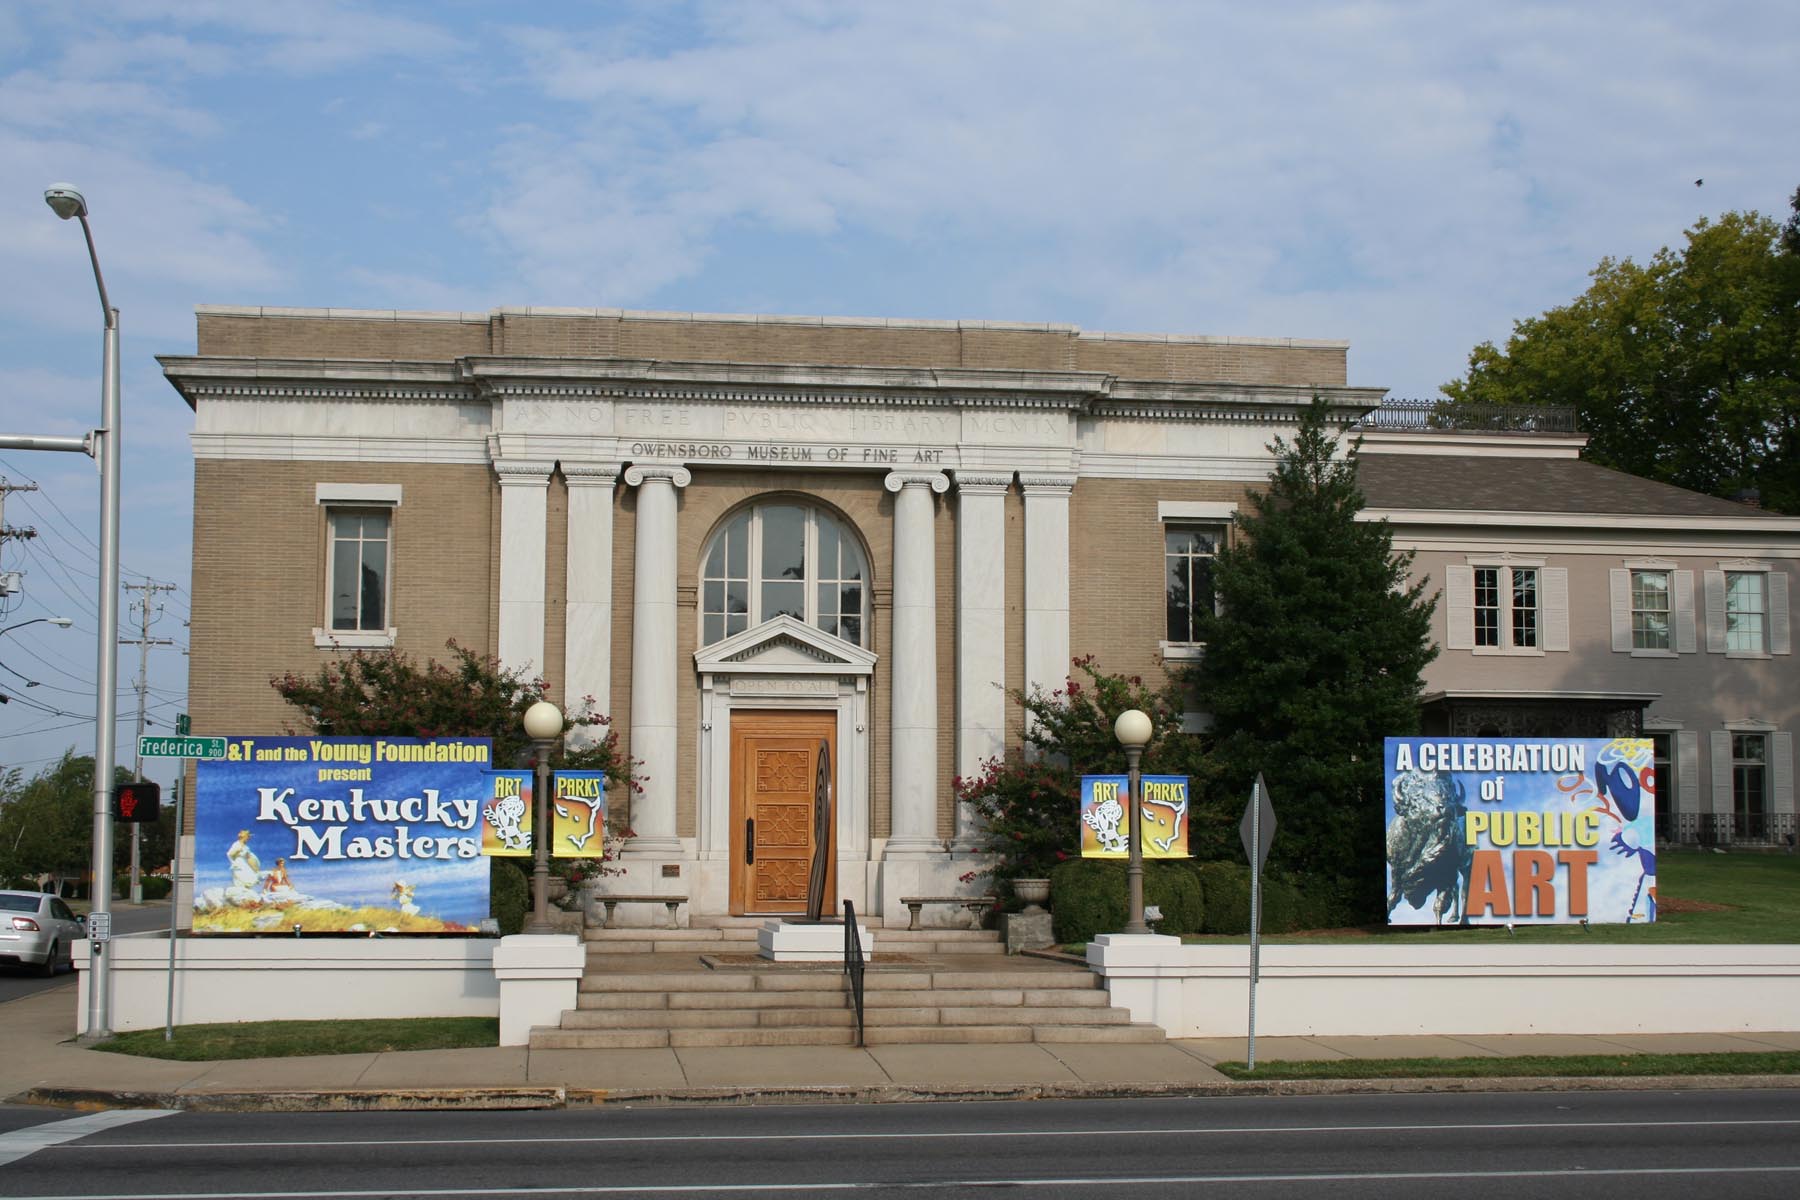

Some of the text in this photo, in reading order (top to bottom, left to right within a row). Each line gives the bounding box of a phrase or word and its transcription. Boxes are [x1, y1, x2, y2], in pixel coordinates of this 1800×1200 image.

[625, 408, 690, 426] FREE
[849, 414, 949, 432] LIBRARY
[631, 442, 944, 464] OWENSBORO MUSEUM OF FINE ART
[735, 680, 833, 692] OPEN TO ALL
[139, 738, 203, 756] Frederica
[208, 748, 223, 757] 900
[256, 747, 283, 761] and
[285, 747, 308, 761] the
[310, 740, 372, 764] Young
[376, 741, 488, 763] Foundation
[1396, 743, 1585, 772] A CELEBRATION
[318, 768, 372, 782] present
[494, 776, 522, 798] ART
[557, 776, 600, 798] PARKS
[1093, 781, 1119, 802] ART
[1143, 781, 1185, 803] PARKS
[1480, 776, 1505, 801] of
[256, 787, 479, 830] Kentucky
[1465, 811, 1600, 846] PUBLIC
[290, 825, 479, 860] Masters
[1466, 850, 1599, 917] ART
